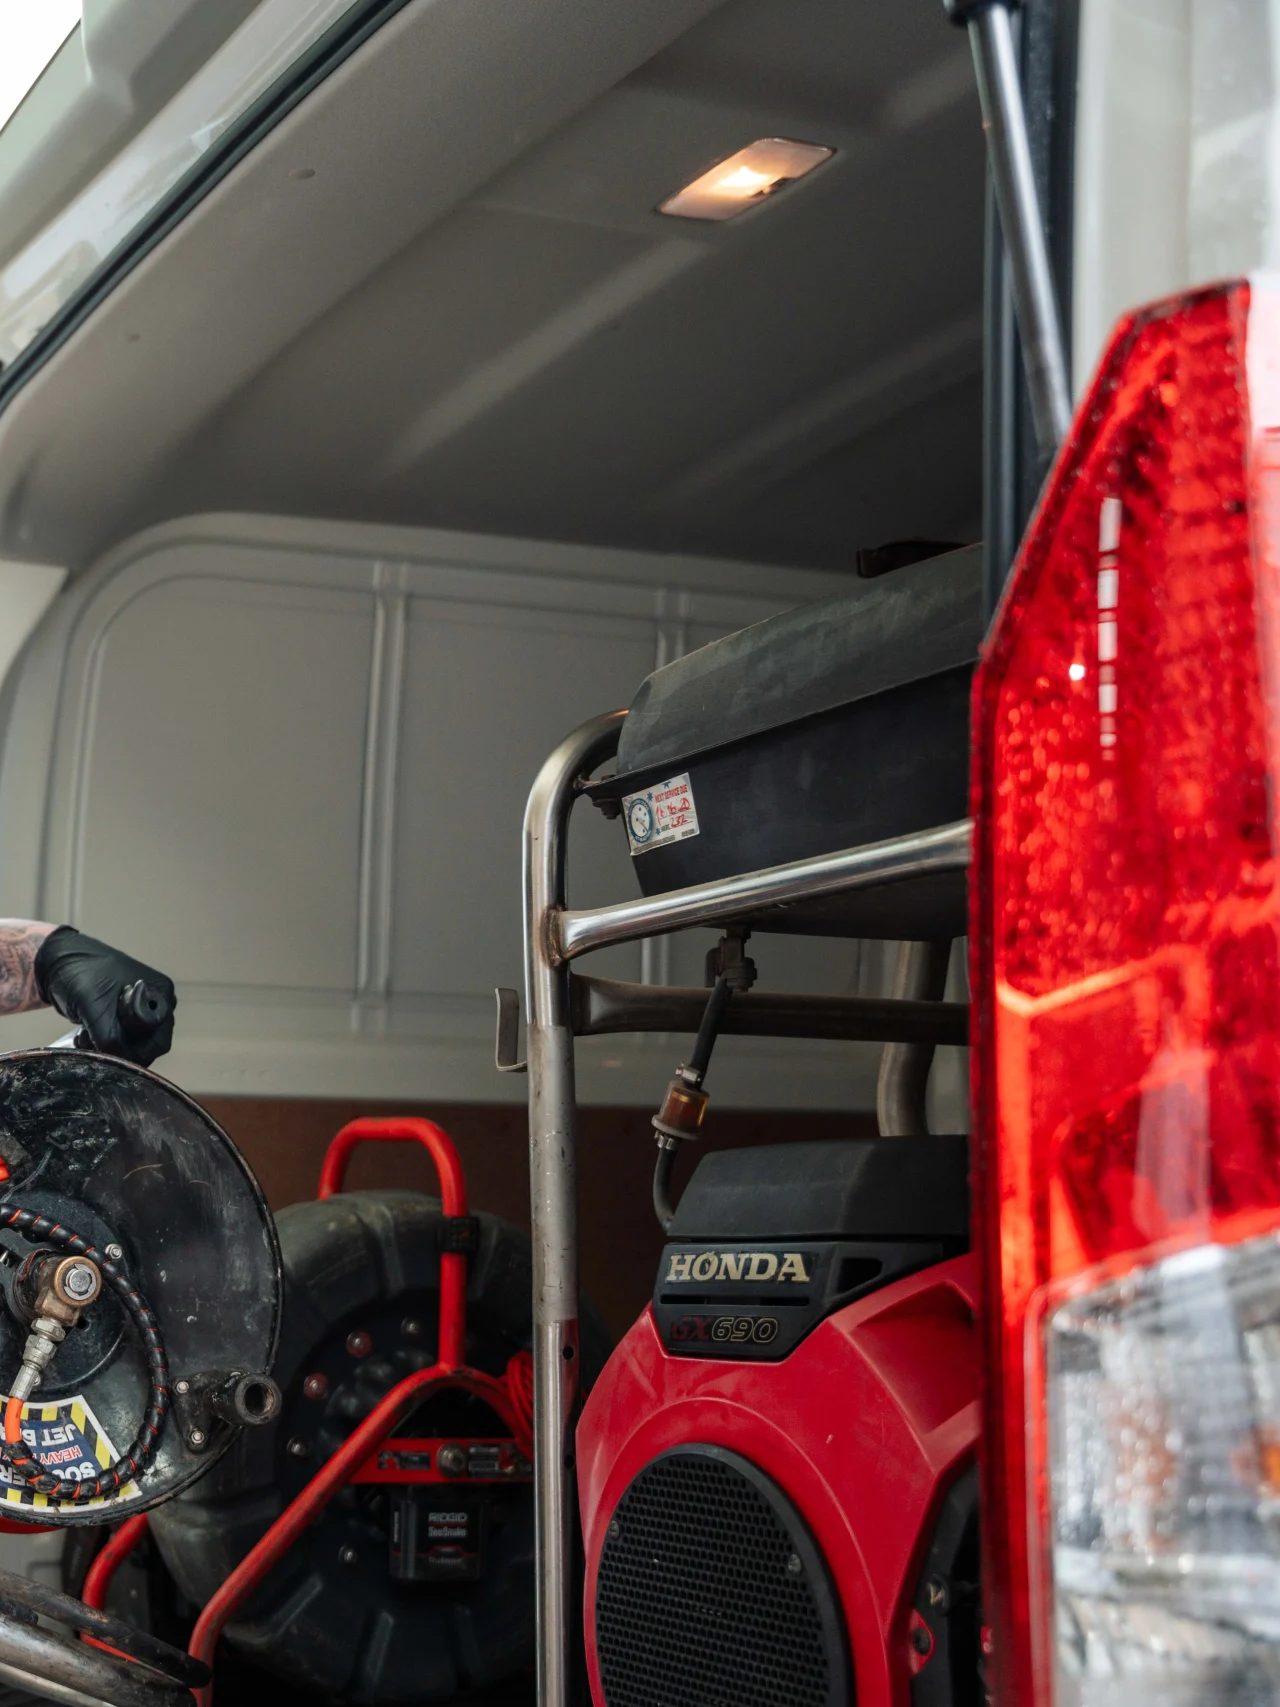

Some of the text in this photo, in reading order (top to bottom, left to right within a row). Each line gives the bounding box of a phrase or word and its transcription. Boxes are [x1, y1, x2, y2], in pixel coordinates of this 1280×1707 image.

[665, 1252, 811, 1283] HONDA
[41, 1423, 76, 1446] JET
[40, 1445, 82, 1465] HEAVY
[428, 1512, 468, 1523] RIDGID
